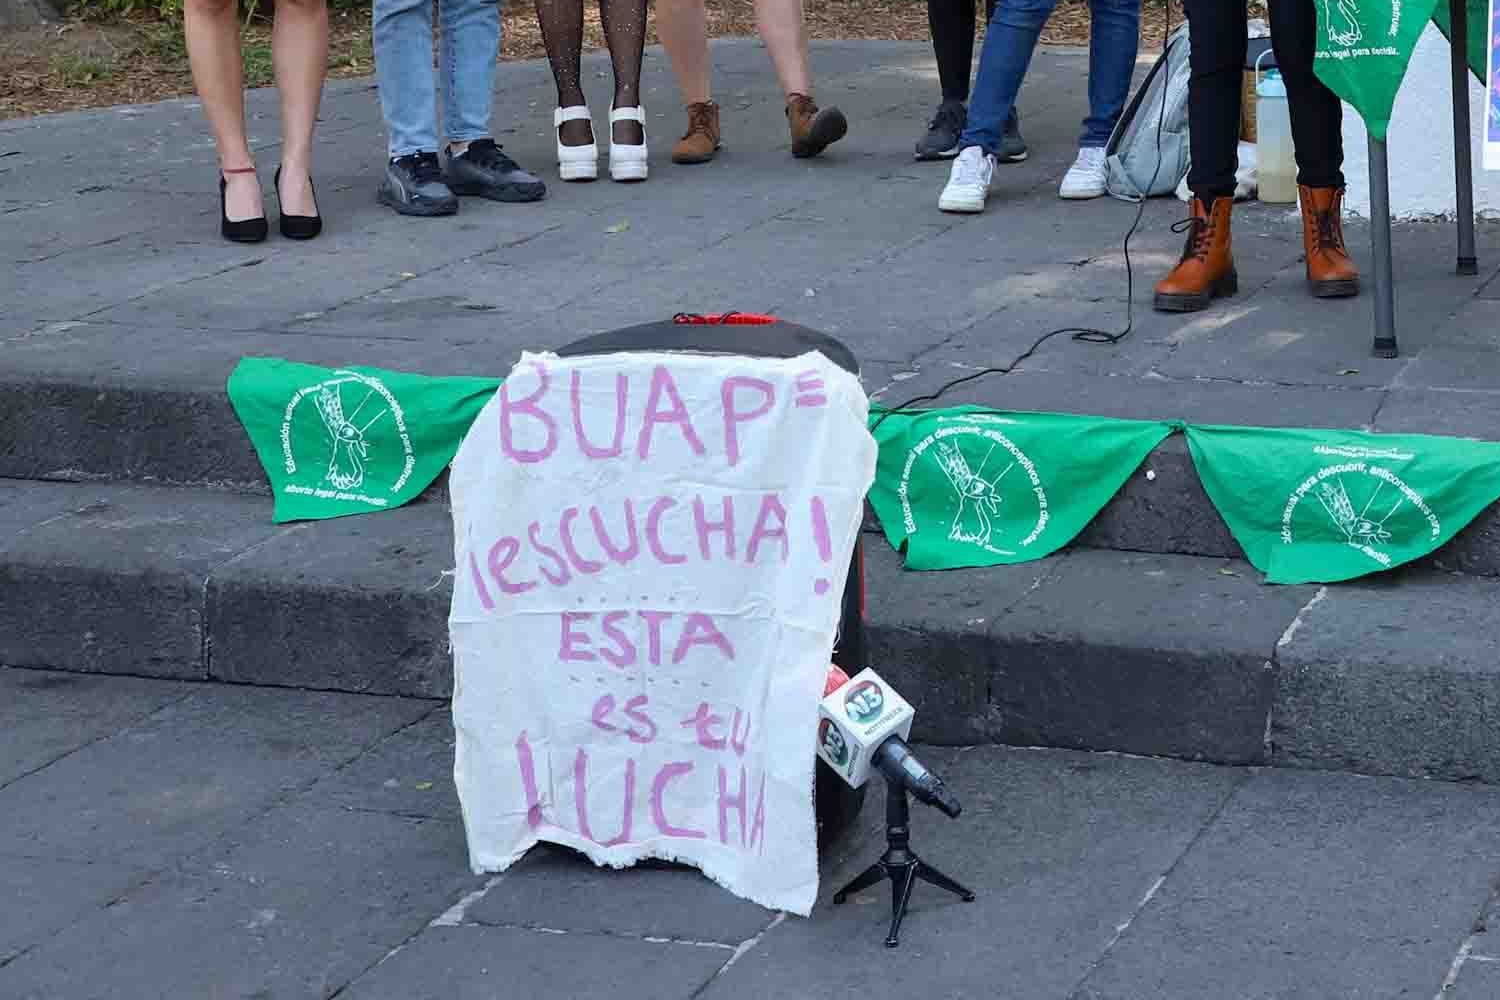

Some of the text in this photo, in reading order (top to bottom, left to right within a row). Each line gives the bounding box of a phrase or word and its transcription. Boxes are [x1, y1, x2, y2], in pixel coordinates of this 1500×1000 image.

[1296, 475, 1319, 497] para
[1033, 487, 1048, 508] para
[558, 610, 736, 668] ESTA
